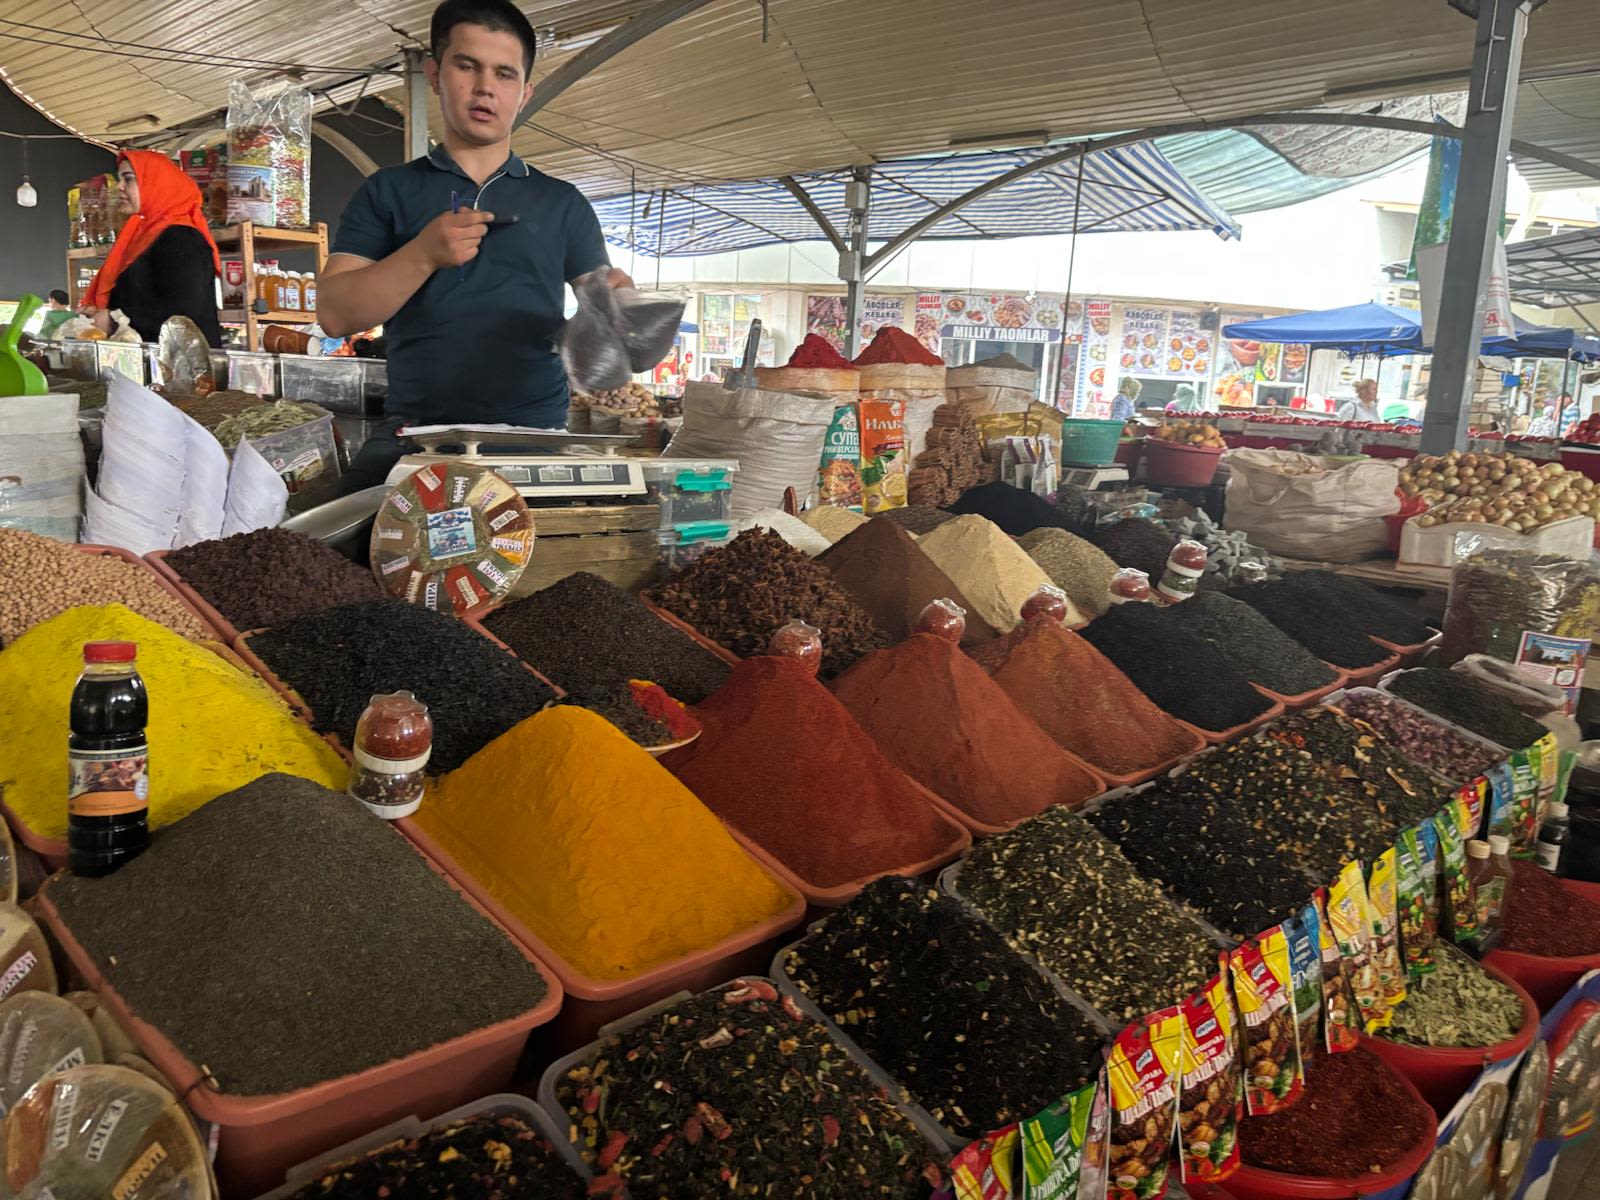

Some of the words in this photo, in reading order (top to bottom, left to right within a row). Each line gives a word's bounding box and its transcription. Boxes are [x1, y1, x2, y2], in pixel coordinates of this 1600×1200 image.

[864, 299, 900, 309] ABOBLAR
[953, 326, 992, 339] MILLIY
[994, 328, 1049, 341] TAOMLAR
